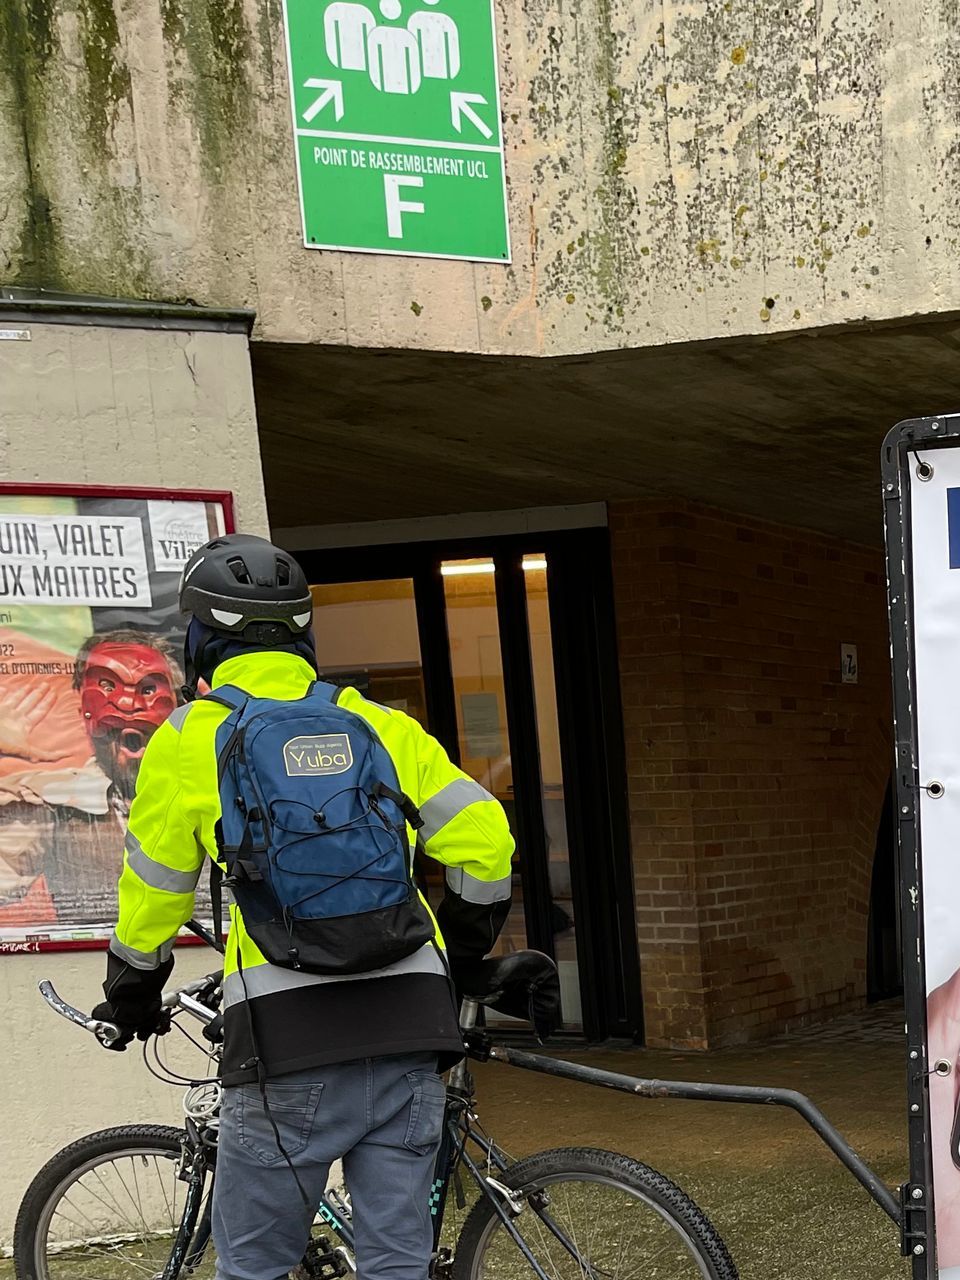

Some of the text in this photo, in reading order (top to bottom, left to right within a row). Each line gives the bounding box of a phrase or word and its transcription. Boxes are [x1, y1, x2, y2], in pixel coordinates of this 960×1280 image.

[313, 146, 489, 179] POINT DE RASSEMBLEMENT UCL
[383, 173, 425, 239] F
[53, 523, 125, 558] VALET
[158, 539, 196, 560] Vila
[32, 565, 139, 599] MAITRES
[289, 750, 347, 768] Yuba
